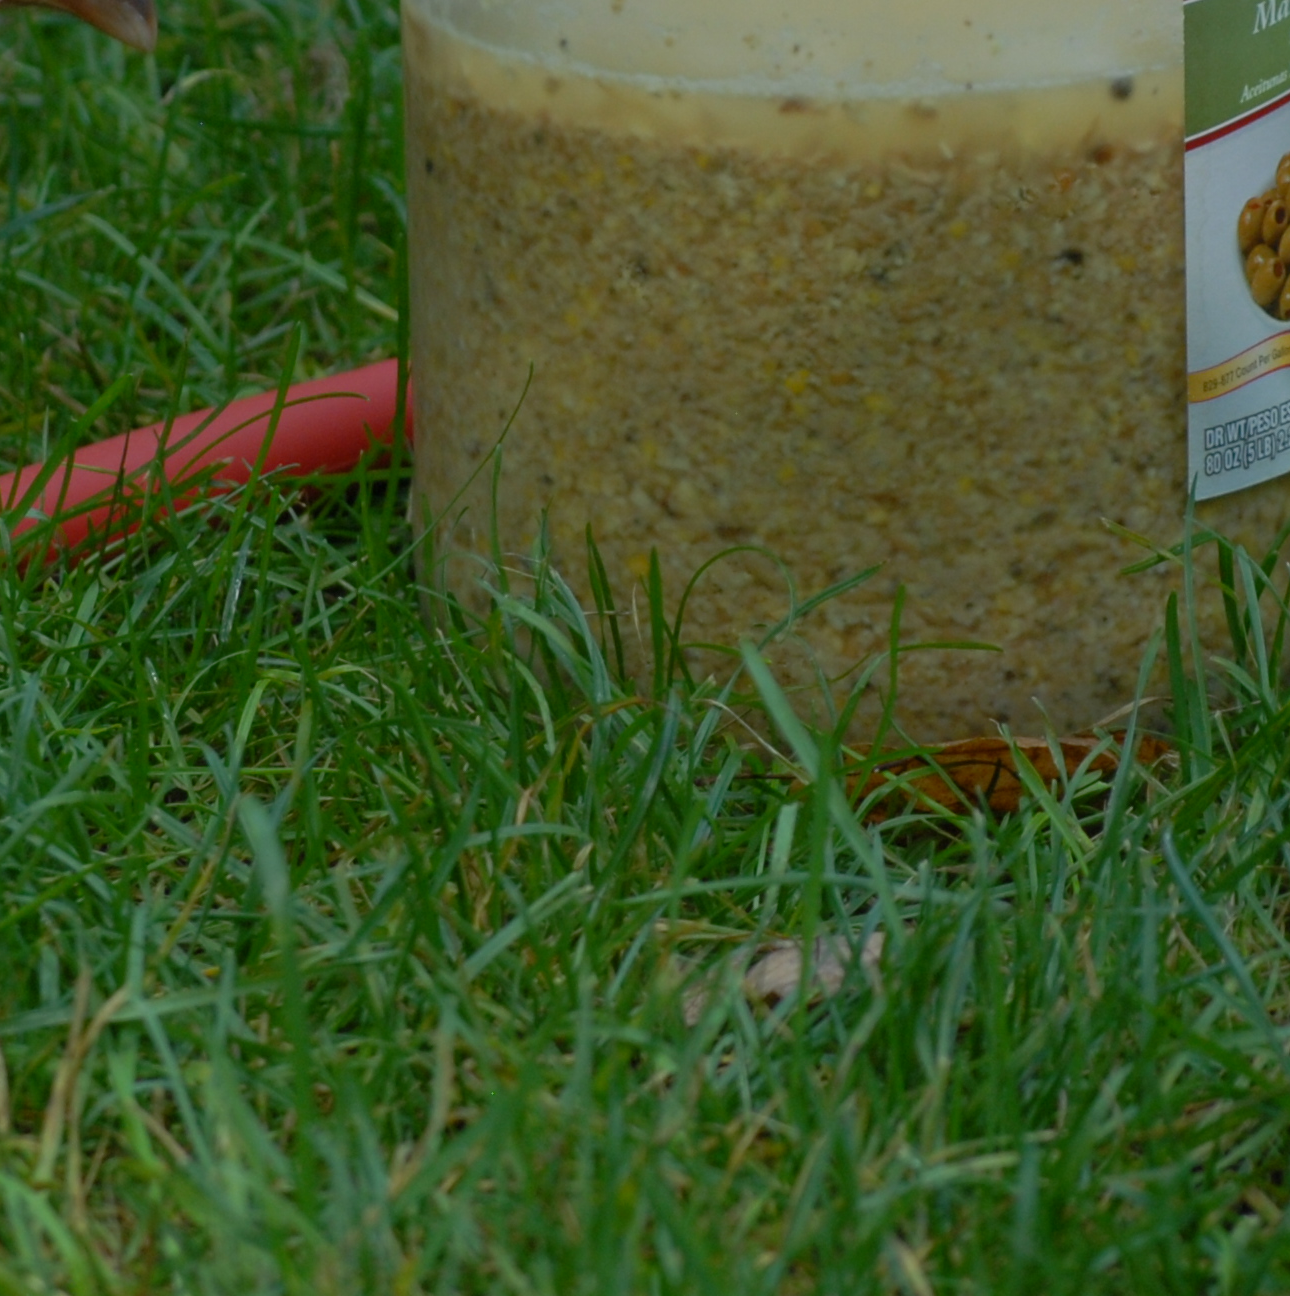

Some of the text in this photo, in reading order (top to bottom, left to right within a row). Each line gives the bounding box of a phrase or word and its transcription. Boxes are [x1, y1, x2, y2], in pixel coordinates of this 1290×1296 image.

[1240, 70, 1288, 103] Aceitunas
[1235, 360, 1258, 379] Count
[1258, 354, 1271, 366] Per
[1204, 425, 1225, 451] DR
[1225, 406, 1280, 444] WT/PESO
[1205, 450, 1222, 477] 80
[1223, 444, 1242, 471] OZ
[1242, 440, 1256, 470] (5
[1256, 432, 1276, 461] LB)
